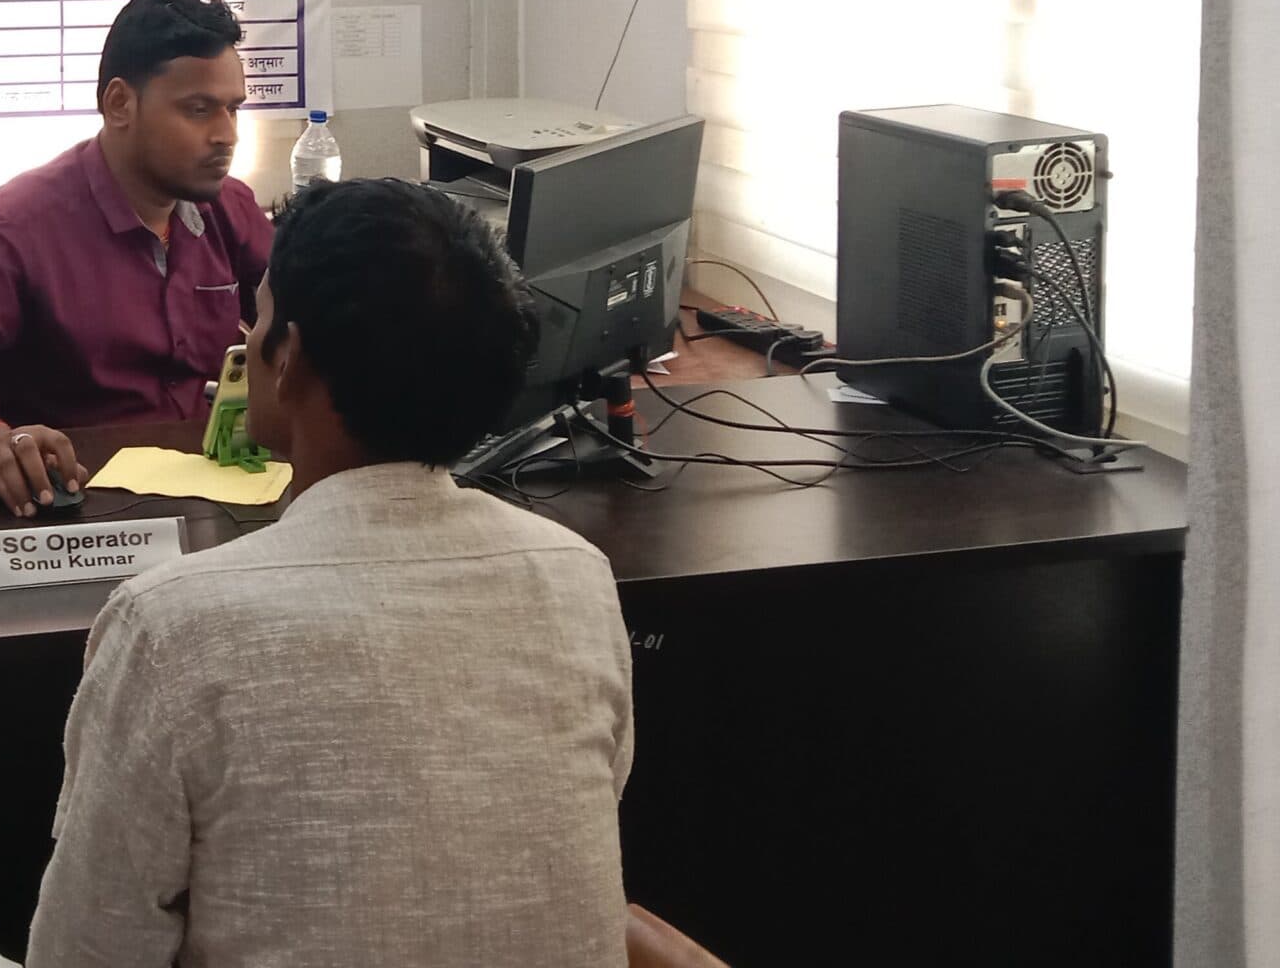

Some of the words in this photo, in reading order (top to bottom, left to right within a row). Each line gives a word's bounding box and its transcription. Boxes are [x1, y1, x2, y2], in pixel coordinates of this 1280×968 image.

[248, 57, 285, 72] अनुसार
[247, 84, 283, 99] अनुसार
[46, 531, 153, 555] Operator
[9, 555, 63, 572] Sonu
[69, 552, 135, 569] Kumar
